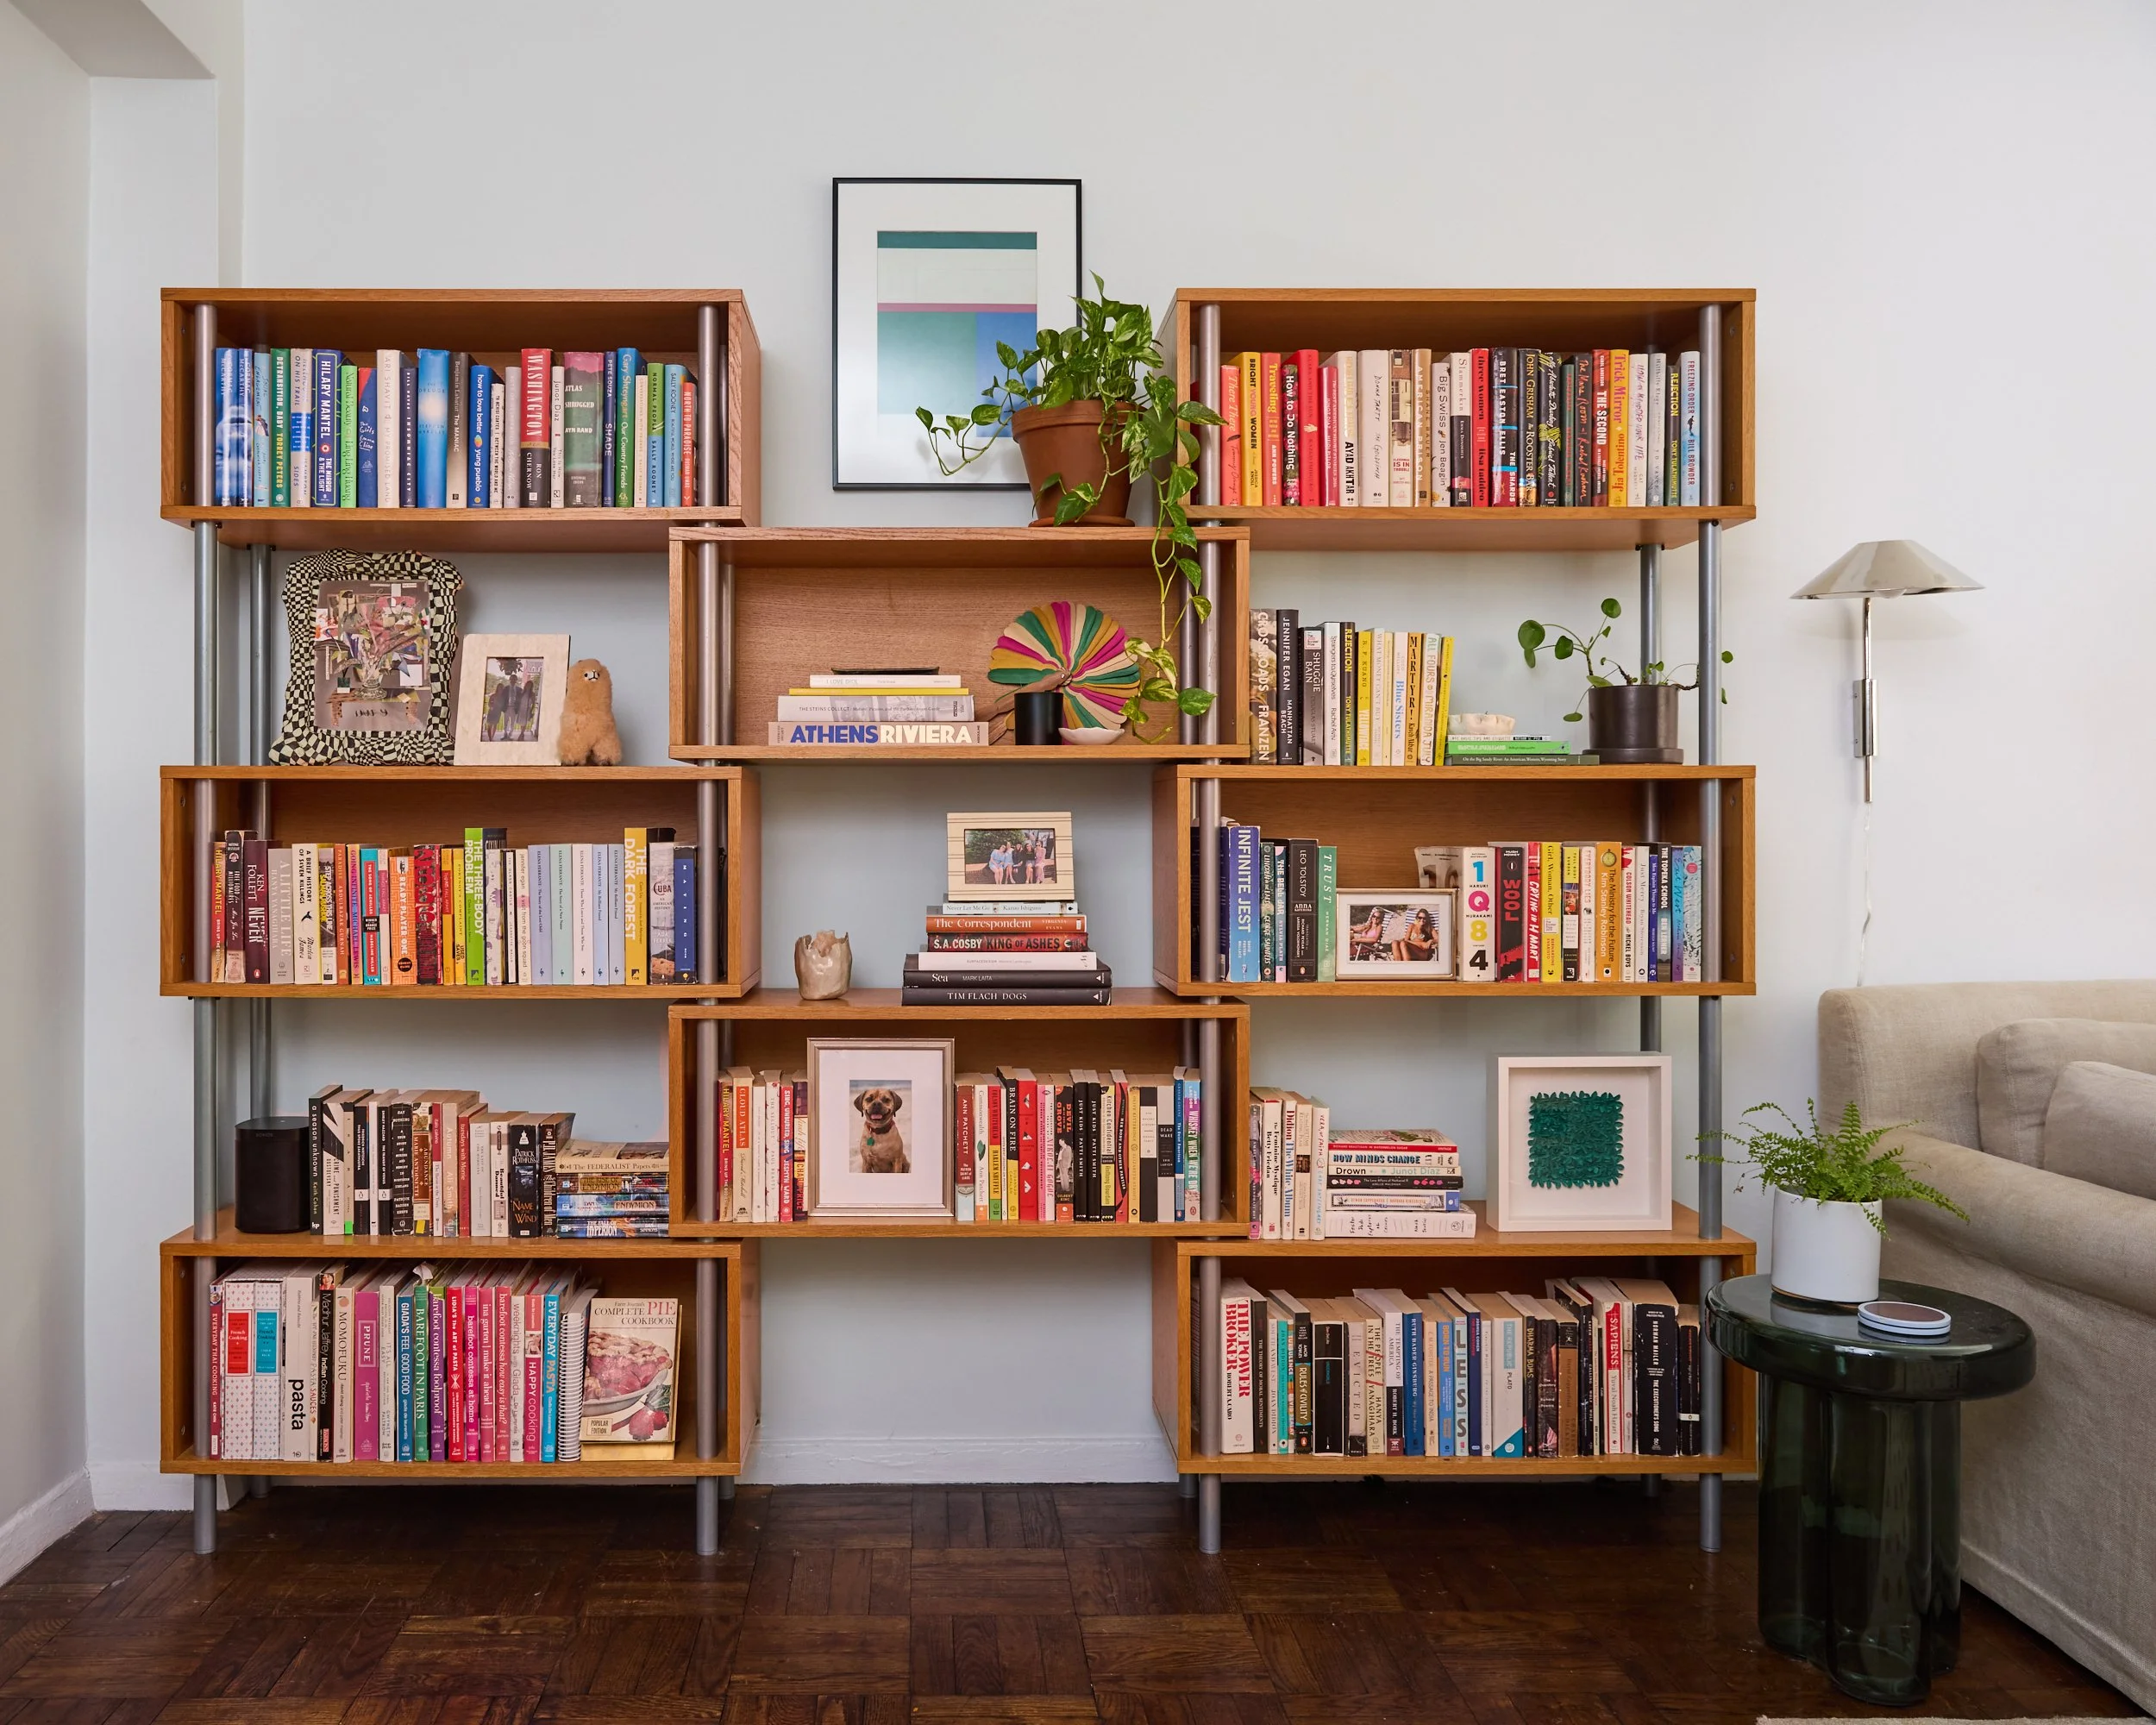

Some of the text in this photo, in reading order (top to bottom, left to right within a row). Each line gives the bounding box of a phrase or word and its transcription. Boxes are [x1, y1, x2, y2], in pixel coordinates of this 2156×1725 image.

[1614, 356, 1626, 423] Trick Mirror
[1687, 361, 1695, 392] FREEZING
[321, 361, 331, 439] HILARY MANTEL
[476, 389, 483, 398] to
[526, 354, 543, 436] WASHINGTON
[1437, 376, 1448, 428] Big Swiss
[1596, 391, 1608, 445] THE SECOND
[605, 423, 613, 456] SHADE
[1345, 442, 1355, 494] AYAD AKHTAR
[1282, 665, 1291, 691] EGAN
[1313, 652, 1321, 693] SHUGGIE
[790, 724, 973, 743] ATHENS RIVIERA
[1258, 705, 1270, 761] FRANZEN
[465, 840, 473, 894] PROBLEM
[636, 847, 647, 875] THE
[1238, 830, 1250, 894] INFINITE
[1473, 861, 1483, 882] 1
[248, 864, 258, 901] FOLLETT
[256, 874, 265, 892] KEN
[474, 839, 485, 936] THE THREE-BODY
[625, 838, 636, 939] DARK FOREST
[1323, 855, 1332, 904] TRUST
[280, 872, 291, 922] LITTLE
[1468, 890, 1489, 912] Q
[1503, 880, 1521, 922] WOOL
[248, 907, 265, 944] NEVER
[934, 918, 1032, 930] The Correspondent
[1238, 898, 1251, 932] JEST
[1470, 919, 1488, 942] 8
[1528, 881, 1539, 962] CRYING IN H MART
[281, 926, 291, 957] LIFE
[953, 938, 982, 949] COSBY
[986, 938, 1012, 949] KING
[1025, 938, 1060, 949] ASHES
[1469, 950, 1489, 971] 4
[931, 973, 949, 982] Sea
[968, 992, 997, 1000] FLACH
[1002, 992, 1027, 1001] DOGS
[1009, 1117, 1016, 1128] ON
[1286, 1110, 1295, 1140] Didion
[512, 1156, 536, 1165] ROTHFUSS
[515, 1149, 535, 1157] PATRICK
[1332, 1154, 1421, 1164] HOW MINDS CHANGE
[401, 1302, 410, 1333] GIADA'S
[648, 1302, 676, 1315] PIE
[401, 1335, 410, 1352] FEEL
[548, 1301, 557, 1357] EVERYDAY
[1225, 1303, 1238, 1371] BROKER
[1610, 1317, 1619, 1365] SAPIENS
[337, 1312, 348, 1381] MOMOFUKU
[1237, 1299, 1250, 1398] THE POWER
[401, 1353, 410, 1374] GOOD
[416, 1308, 425, 1419] BAREFOOT IN PARIS
[546, 1359, 555, 1394] PASTA
[402, 1375, 411, 1395] FOOD
[288, 1379, 306, 1431] pasta
[1300, 1393, 1308, 1421] CIVILITY
